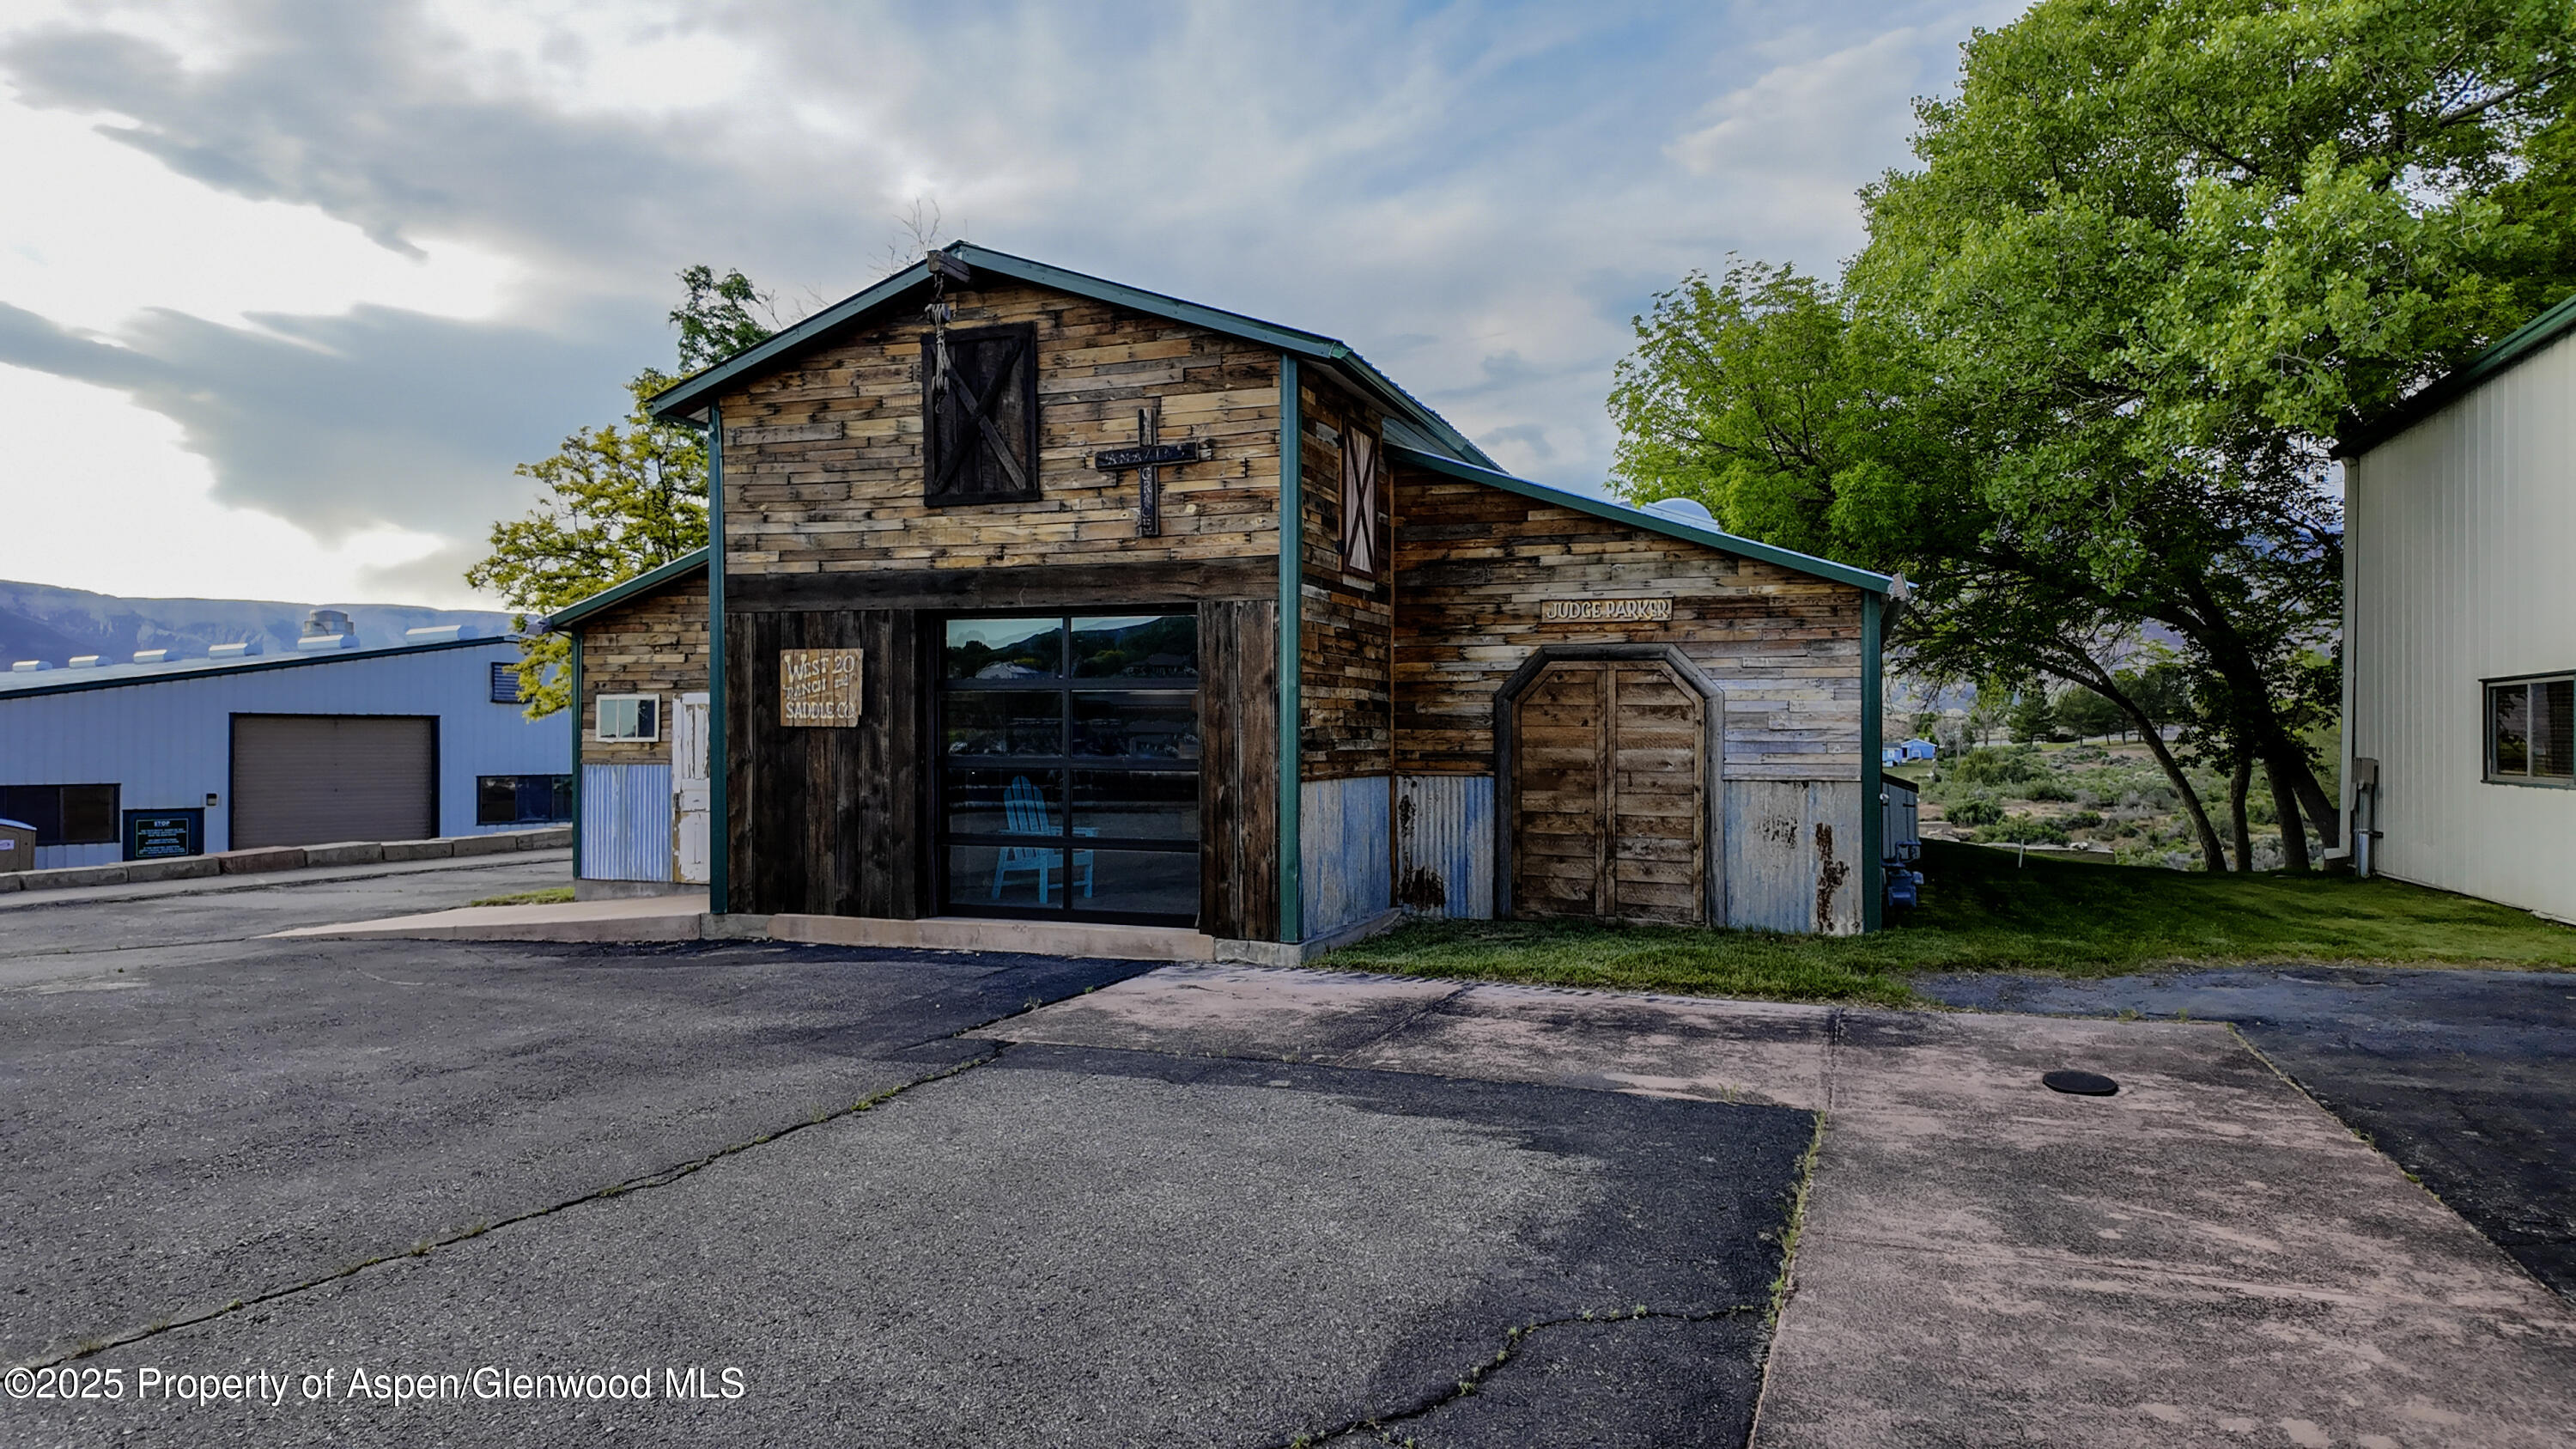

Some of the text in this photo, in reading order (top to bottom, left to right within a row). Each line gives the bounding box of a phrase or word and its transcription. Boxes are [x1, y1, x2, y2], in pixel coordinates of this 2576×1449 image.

[1141, 466, 1152, 532] GRACE
[1546, 600, 1670, 620] JUDGE PARKER
[784, 654, 854, 683] WEST 20
[782, 678, 826, 701] RANCH
[786, 702, 835, 719] SADDLE
